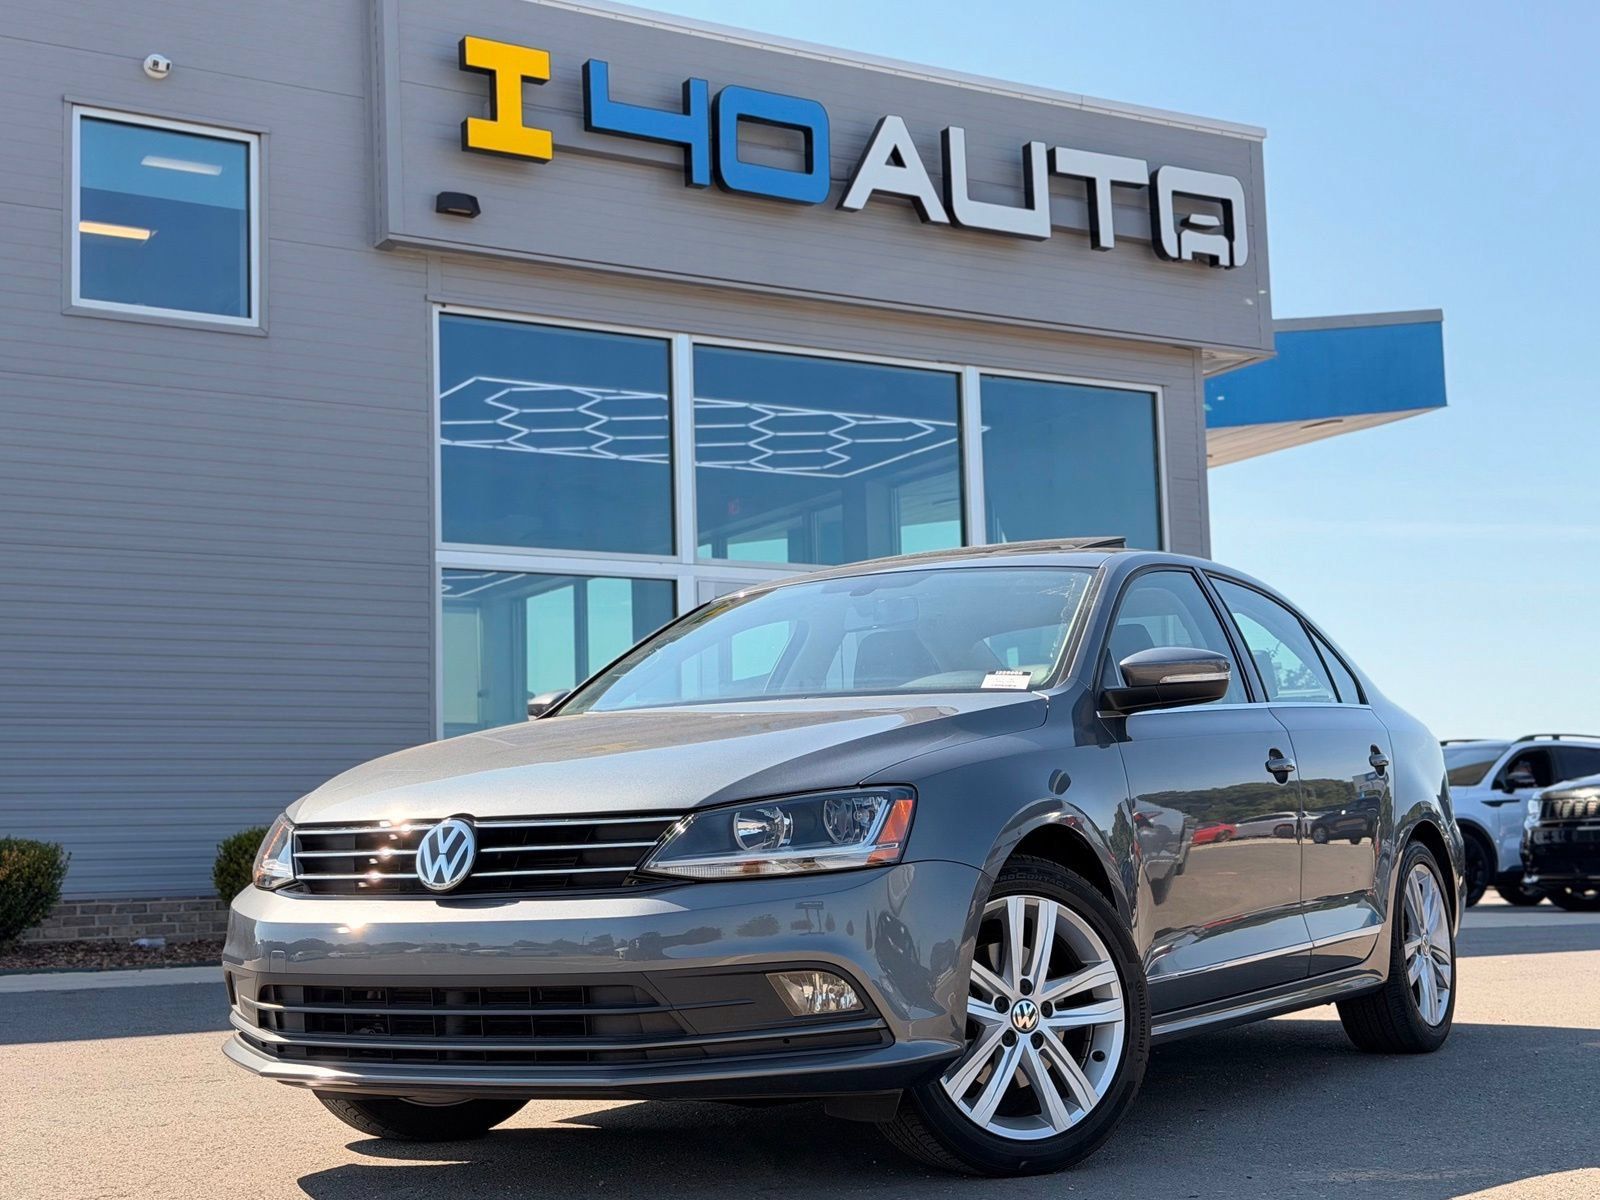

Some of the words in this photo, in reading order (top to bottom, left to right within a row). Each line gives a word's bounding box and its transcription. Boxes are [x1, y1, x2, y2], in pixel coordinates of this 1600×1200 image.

[837, 115, 1248, 269] AUTO
[417, 819, 474, 890] VW
[1012, 1000, 1038, 1031] VW
